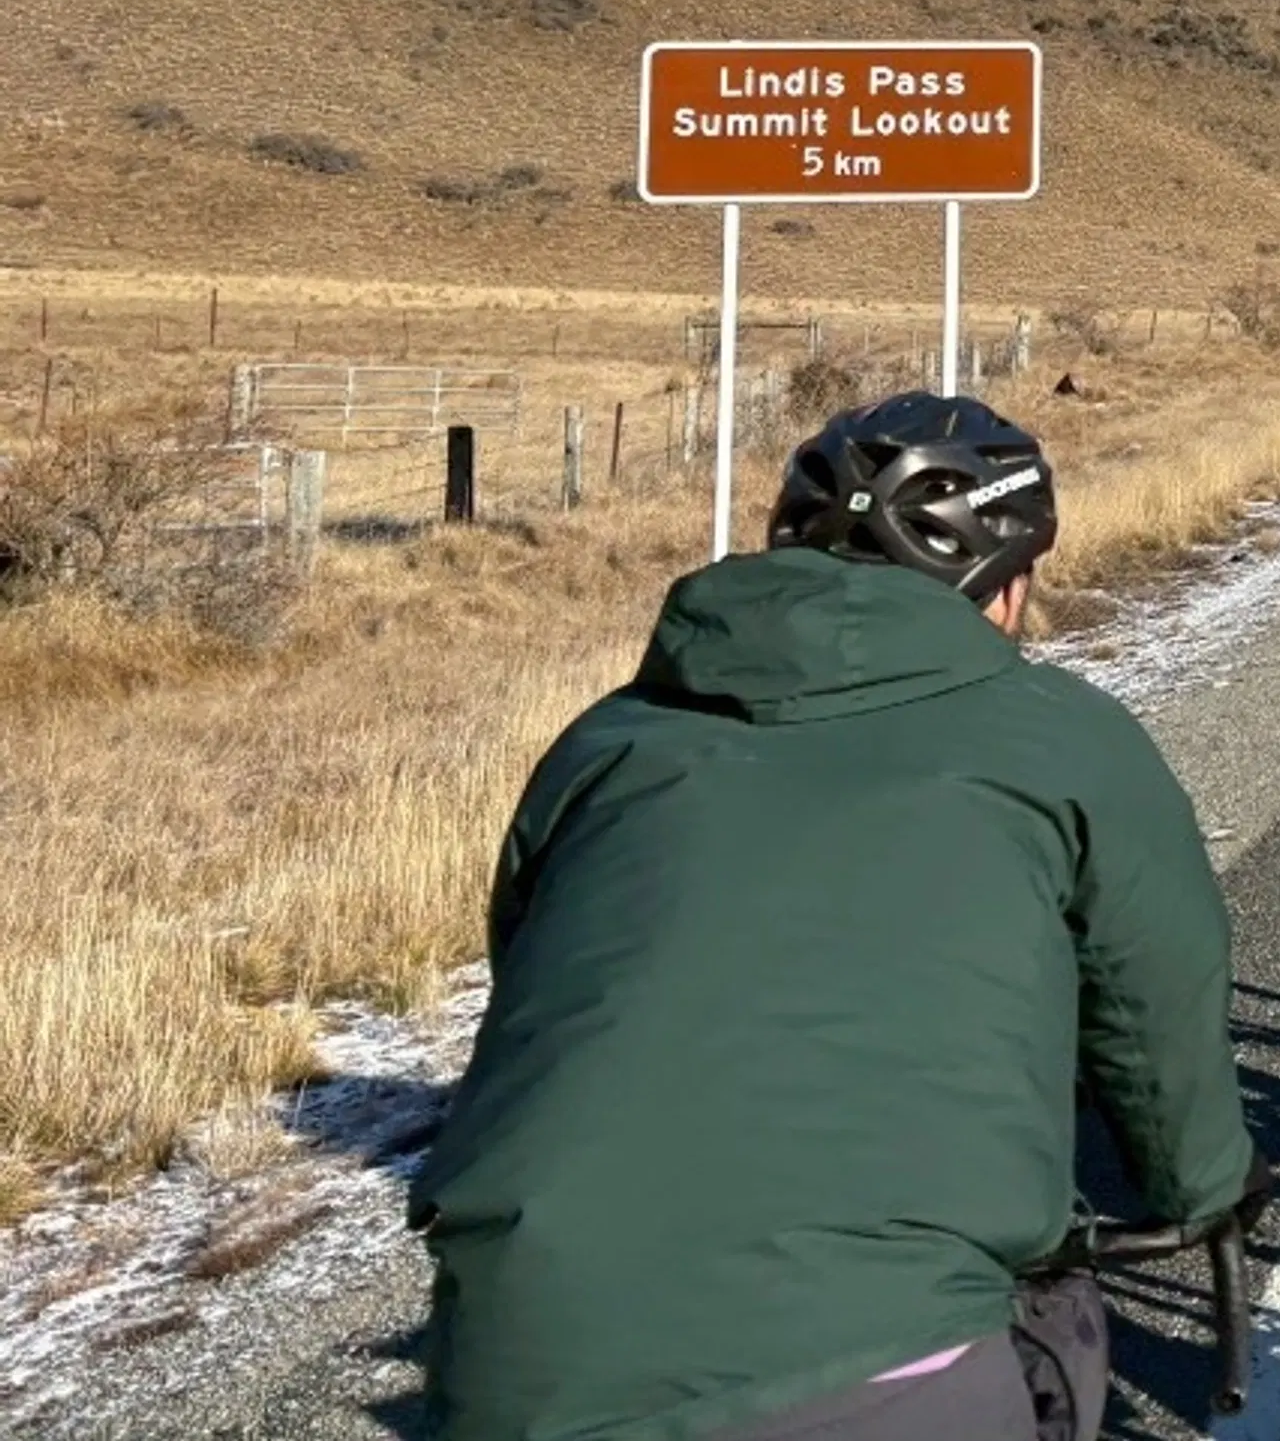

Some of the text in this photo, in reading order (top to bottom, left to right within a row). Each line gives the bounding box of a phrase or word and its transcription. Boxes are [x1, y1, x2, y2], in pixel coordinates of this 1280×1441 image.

[719, 65, 966, 98] Lindis Pass
[672, 106, 1012, 137] Summit Lookout
[802, 146, 882, 176] 5 km
